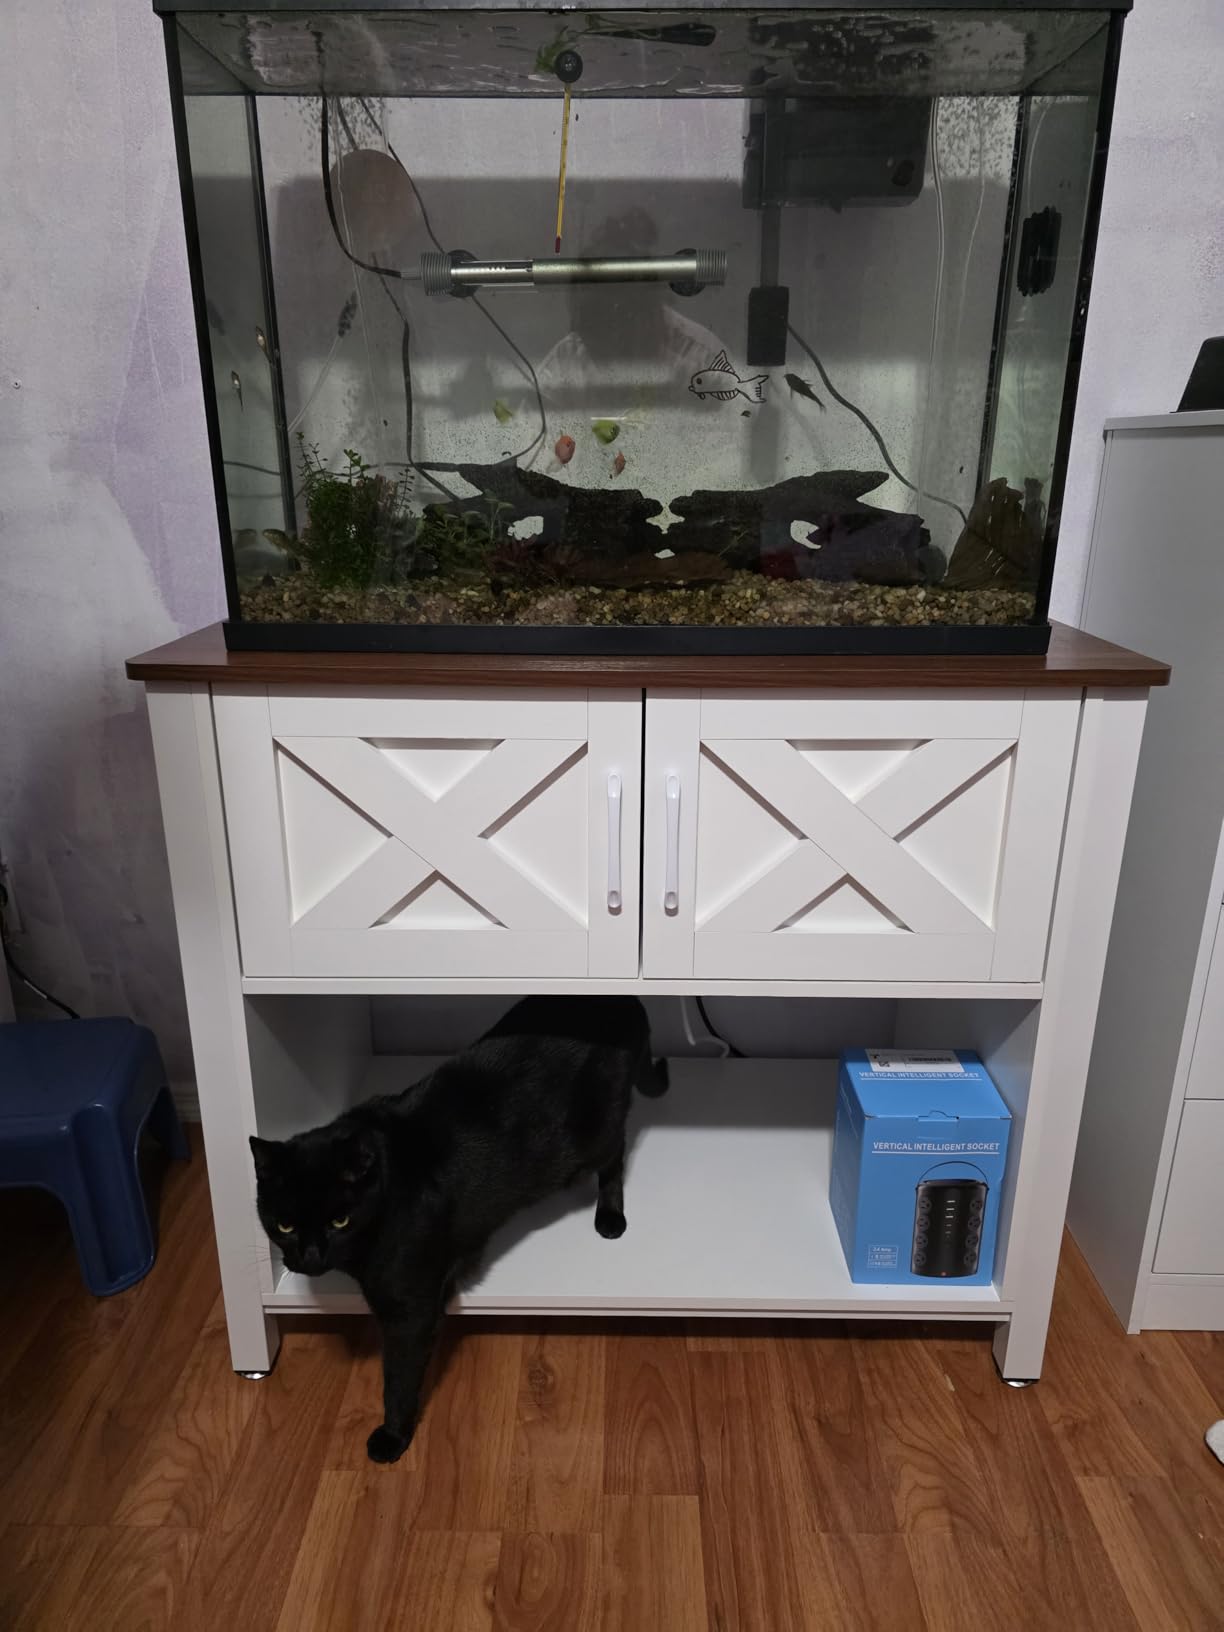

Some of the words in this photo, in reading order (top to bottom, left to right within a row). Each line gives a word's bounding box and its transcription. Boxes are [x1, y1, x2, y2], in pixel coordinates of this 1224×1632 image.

[873, 1142, 913, 1150] VERTICAL
[914, 1142, 966, 1151] INTELLIGENT
[967, 1143, 1001, 1151] SOCKET
